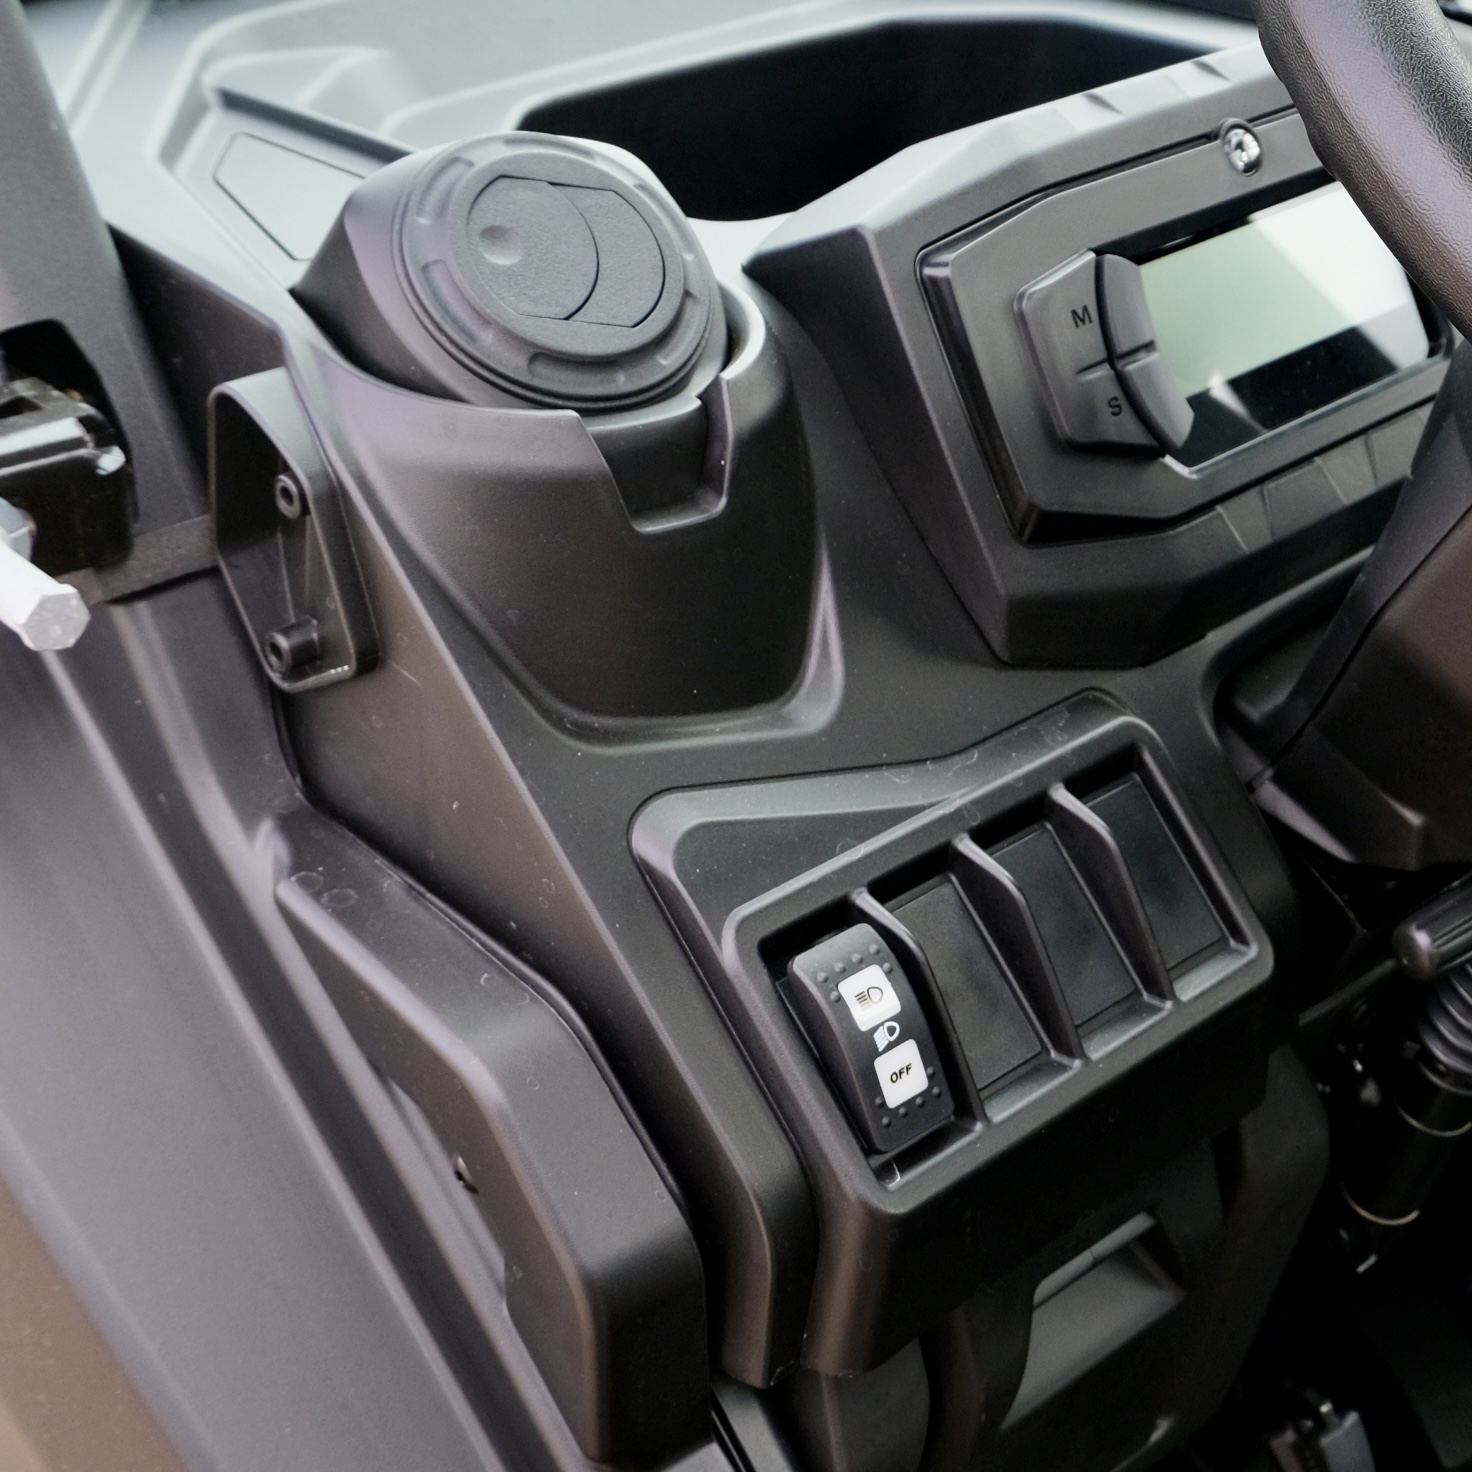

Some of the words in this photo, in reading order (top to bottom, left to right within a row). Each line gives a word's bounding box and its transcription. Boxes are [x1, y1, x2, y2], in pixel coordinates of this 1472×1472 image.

[1071, 304, 1093, 329] M
[1107, 396, 1122, 416] S
[890, 1062, 912, 1084] OFF
